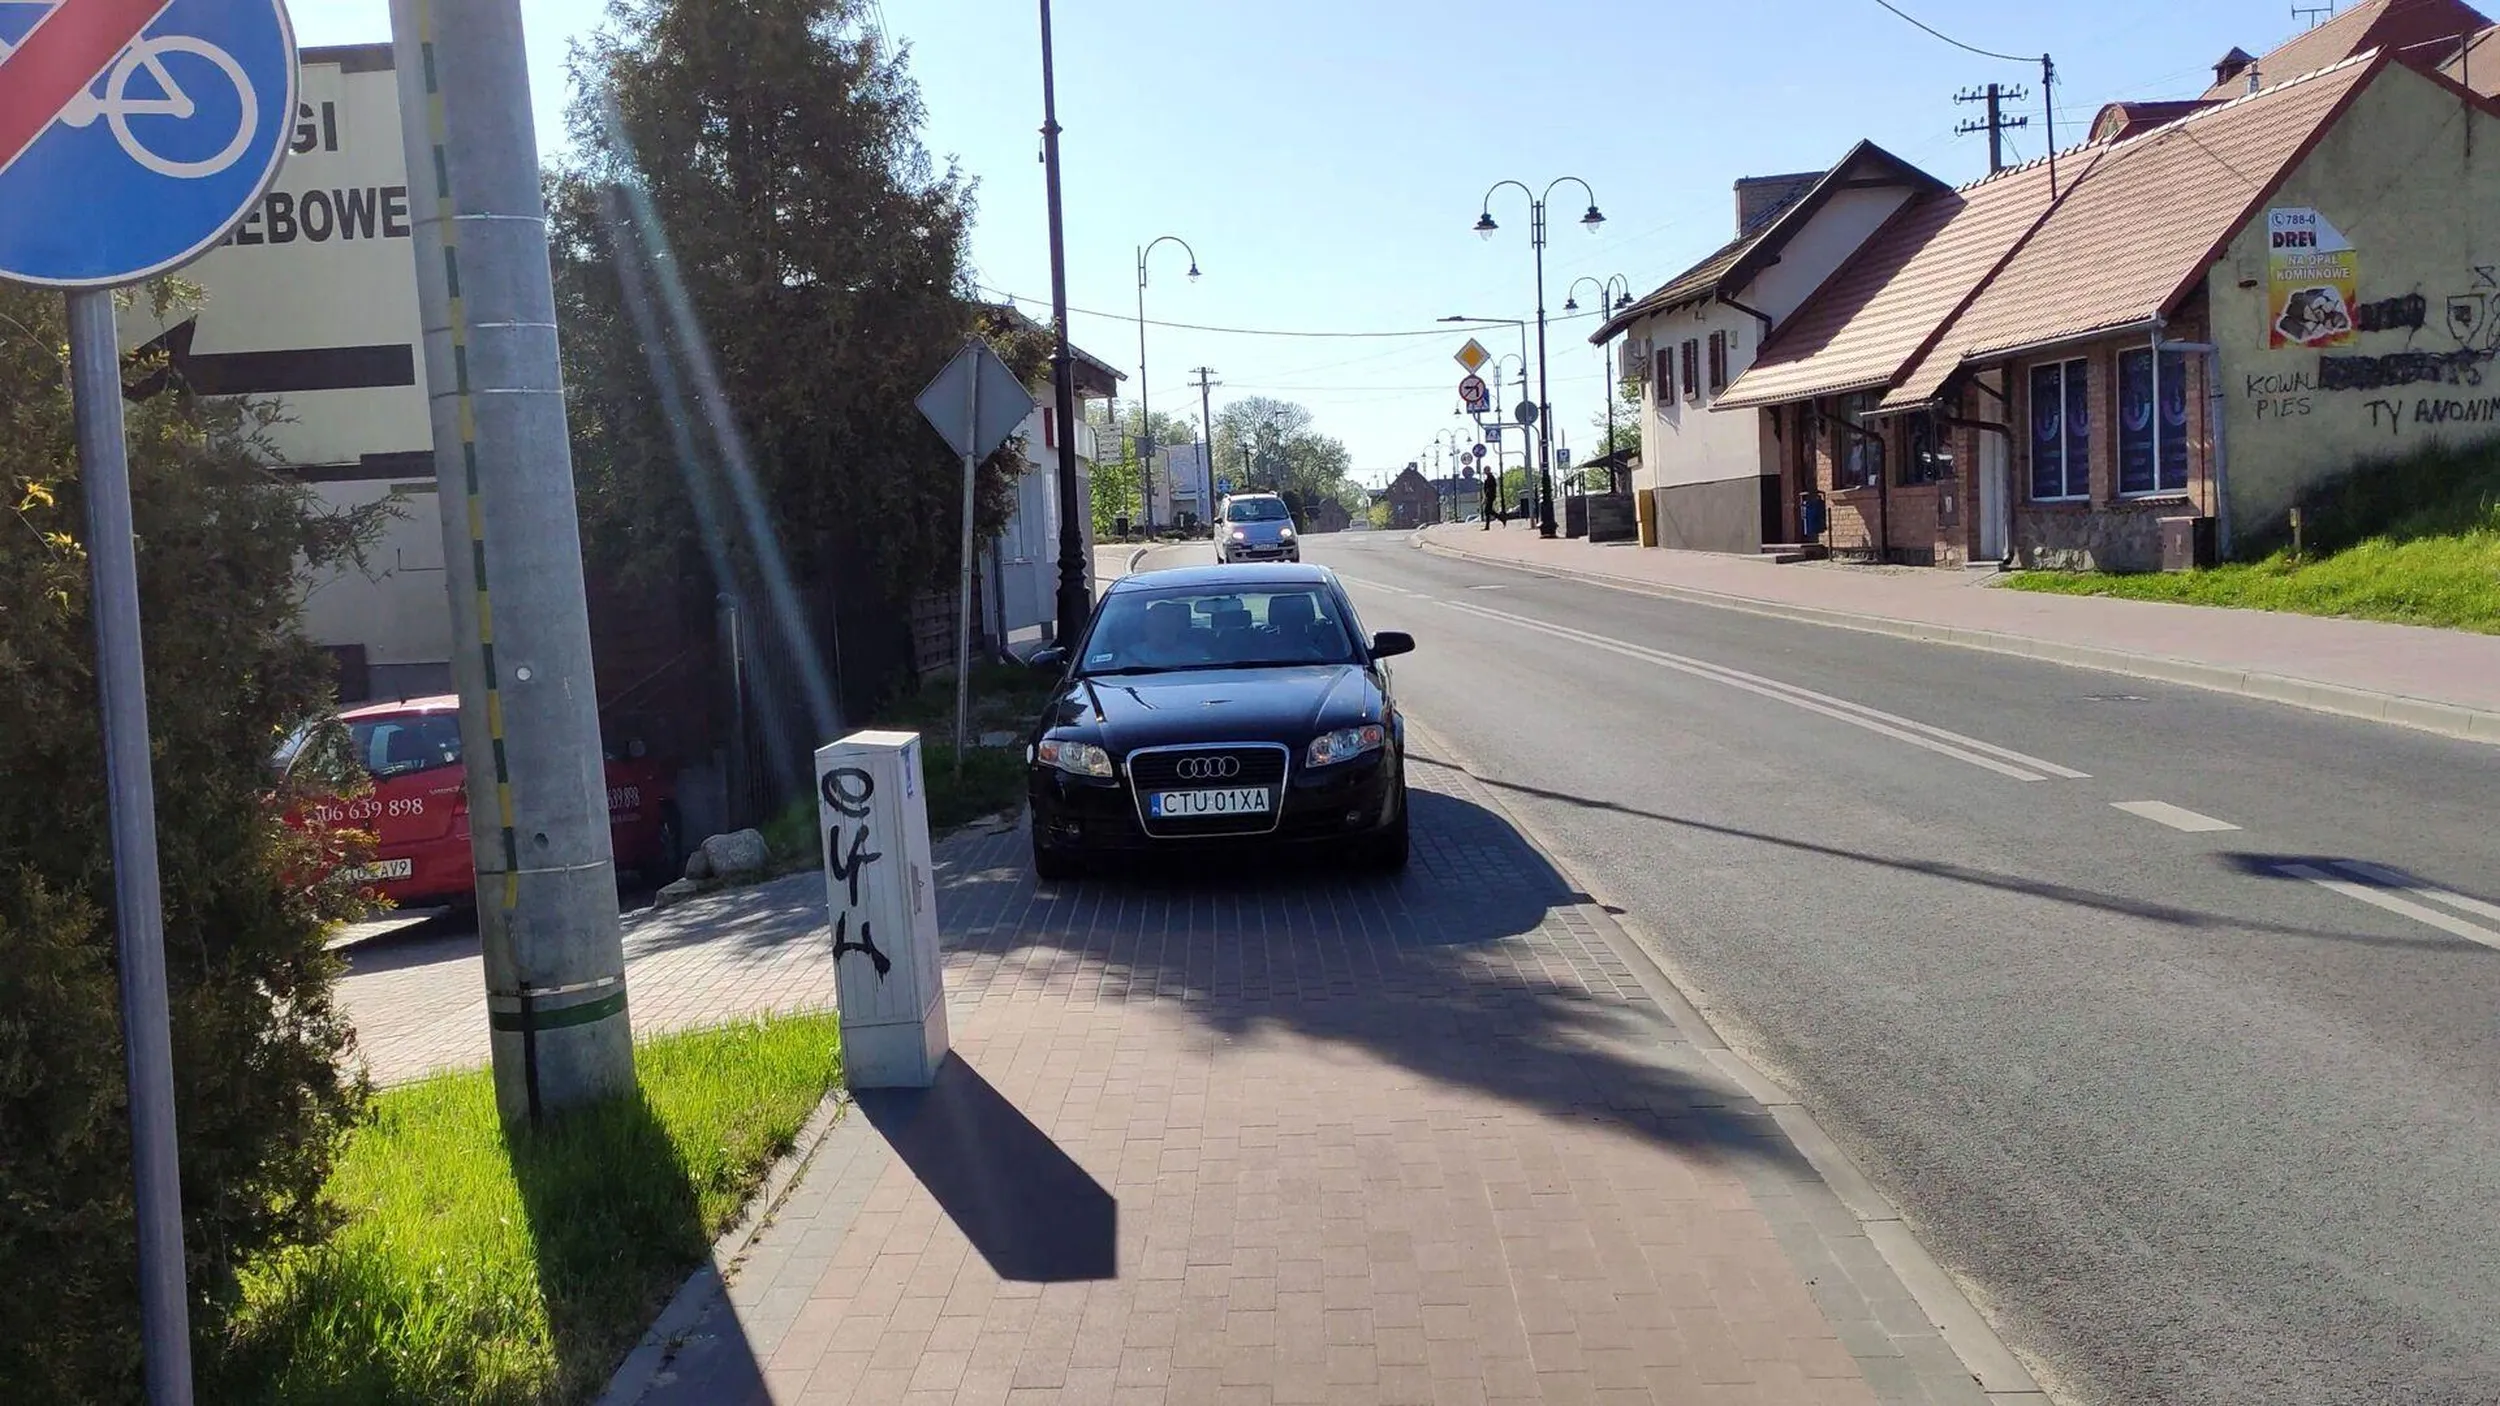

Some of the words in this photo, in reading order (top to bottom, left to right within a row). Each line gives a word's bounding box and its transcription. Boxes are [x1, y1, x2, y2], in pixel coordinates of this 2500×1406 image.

[2256, 397, 2311, 420] PIES
[2363, 399, 2402, 436] TY
[349, 801, 382, 819] 639
[388, 798, 424, 818] 898
[1164, 792, 1207, 813] CTU
